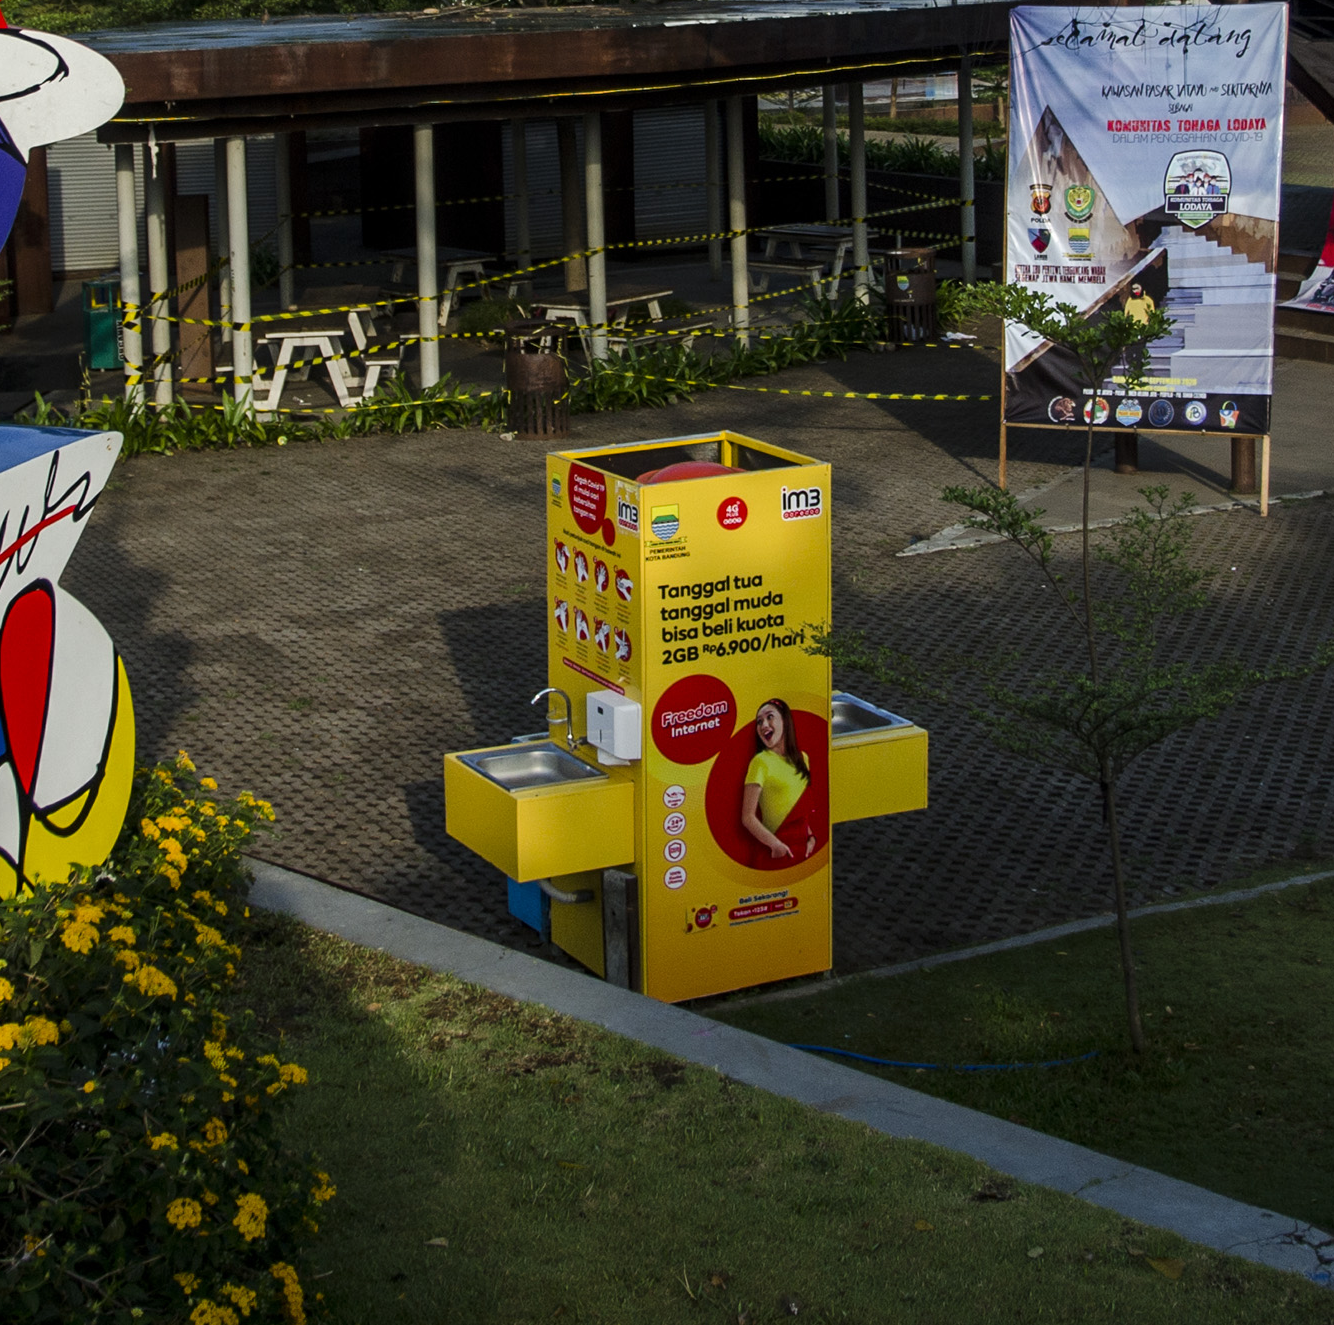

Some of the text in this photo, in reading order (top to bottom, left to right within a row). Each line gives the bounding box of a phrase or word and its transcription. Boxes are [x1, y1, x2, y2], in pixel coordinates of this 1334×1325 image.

[1158, 23, 1252, 58] datang
[1101, 83, 1143, 99] KAWASAN
[1145, 84, 1176, 100] PASAR
[1220, 81, 1273, 98] SEKITARNYA
[1168, 103, 1193, 114] SEBAGAI
[1107, 118, 1267, 132] KOMUNITAS TOHAGA LODAYA
[1112, 132, 1263, 144] DALAM PENCEGAHAN COVID-19
[1179, 203, 1213, 211] LODAYA
[726, 504, 739, 513] 4G
[650, 545, 686, 555] PEMERINTAH
[662, 551, 690, 560] BANDUNG
[658, 575, 763, 600] Tanggal tua
[660, 591, 783, 622] tanggal muda
[662, 614, 785, 643] bisa beli kuota
[662, 646, 699, 665] 2GB
[661, 700, 728, 728] Freedom
[671, 717, 720, 738] Internet
